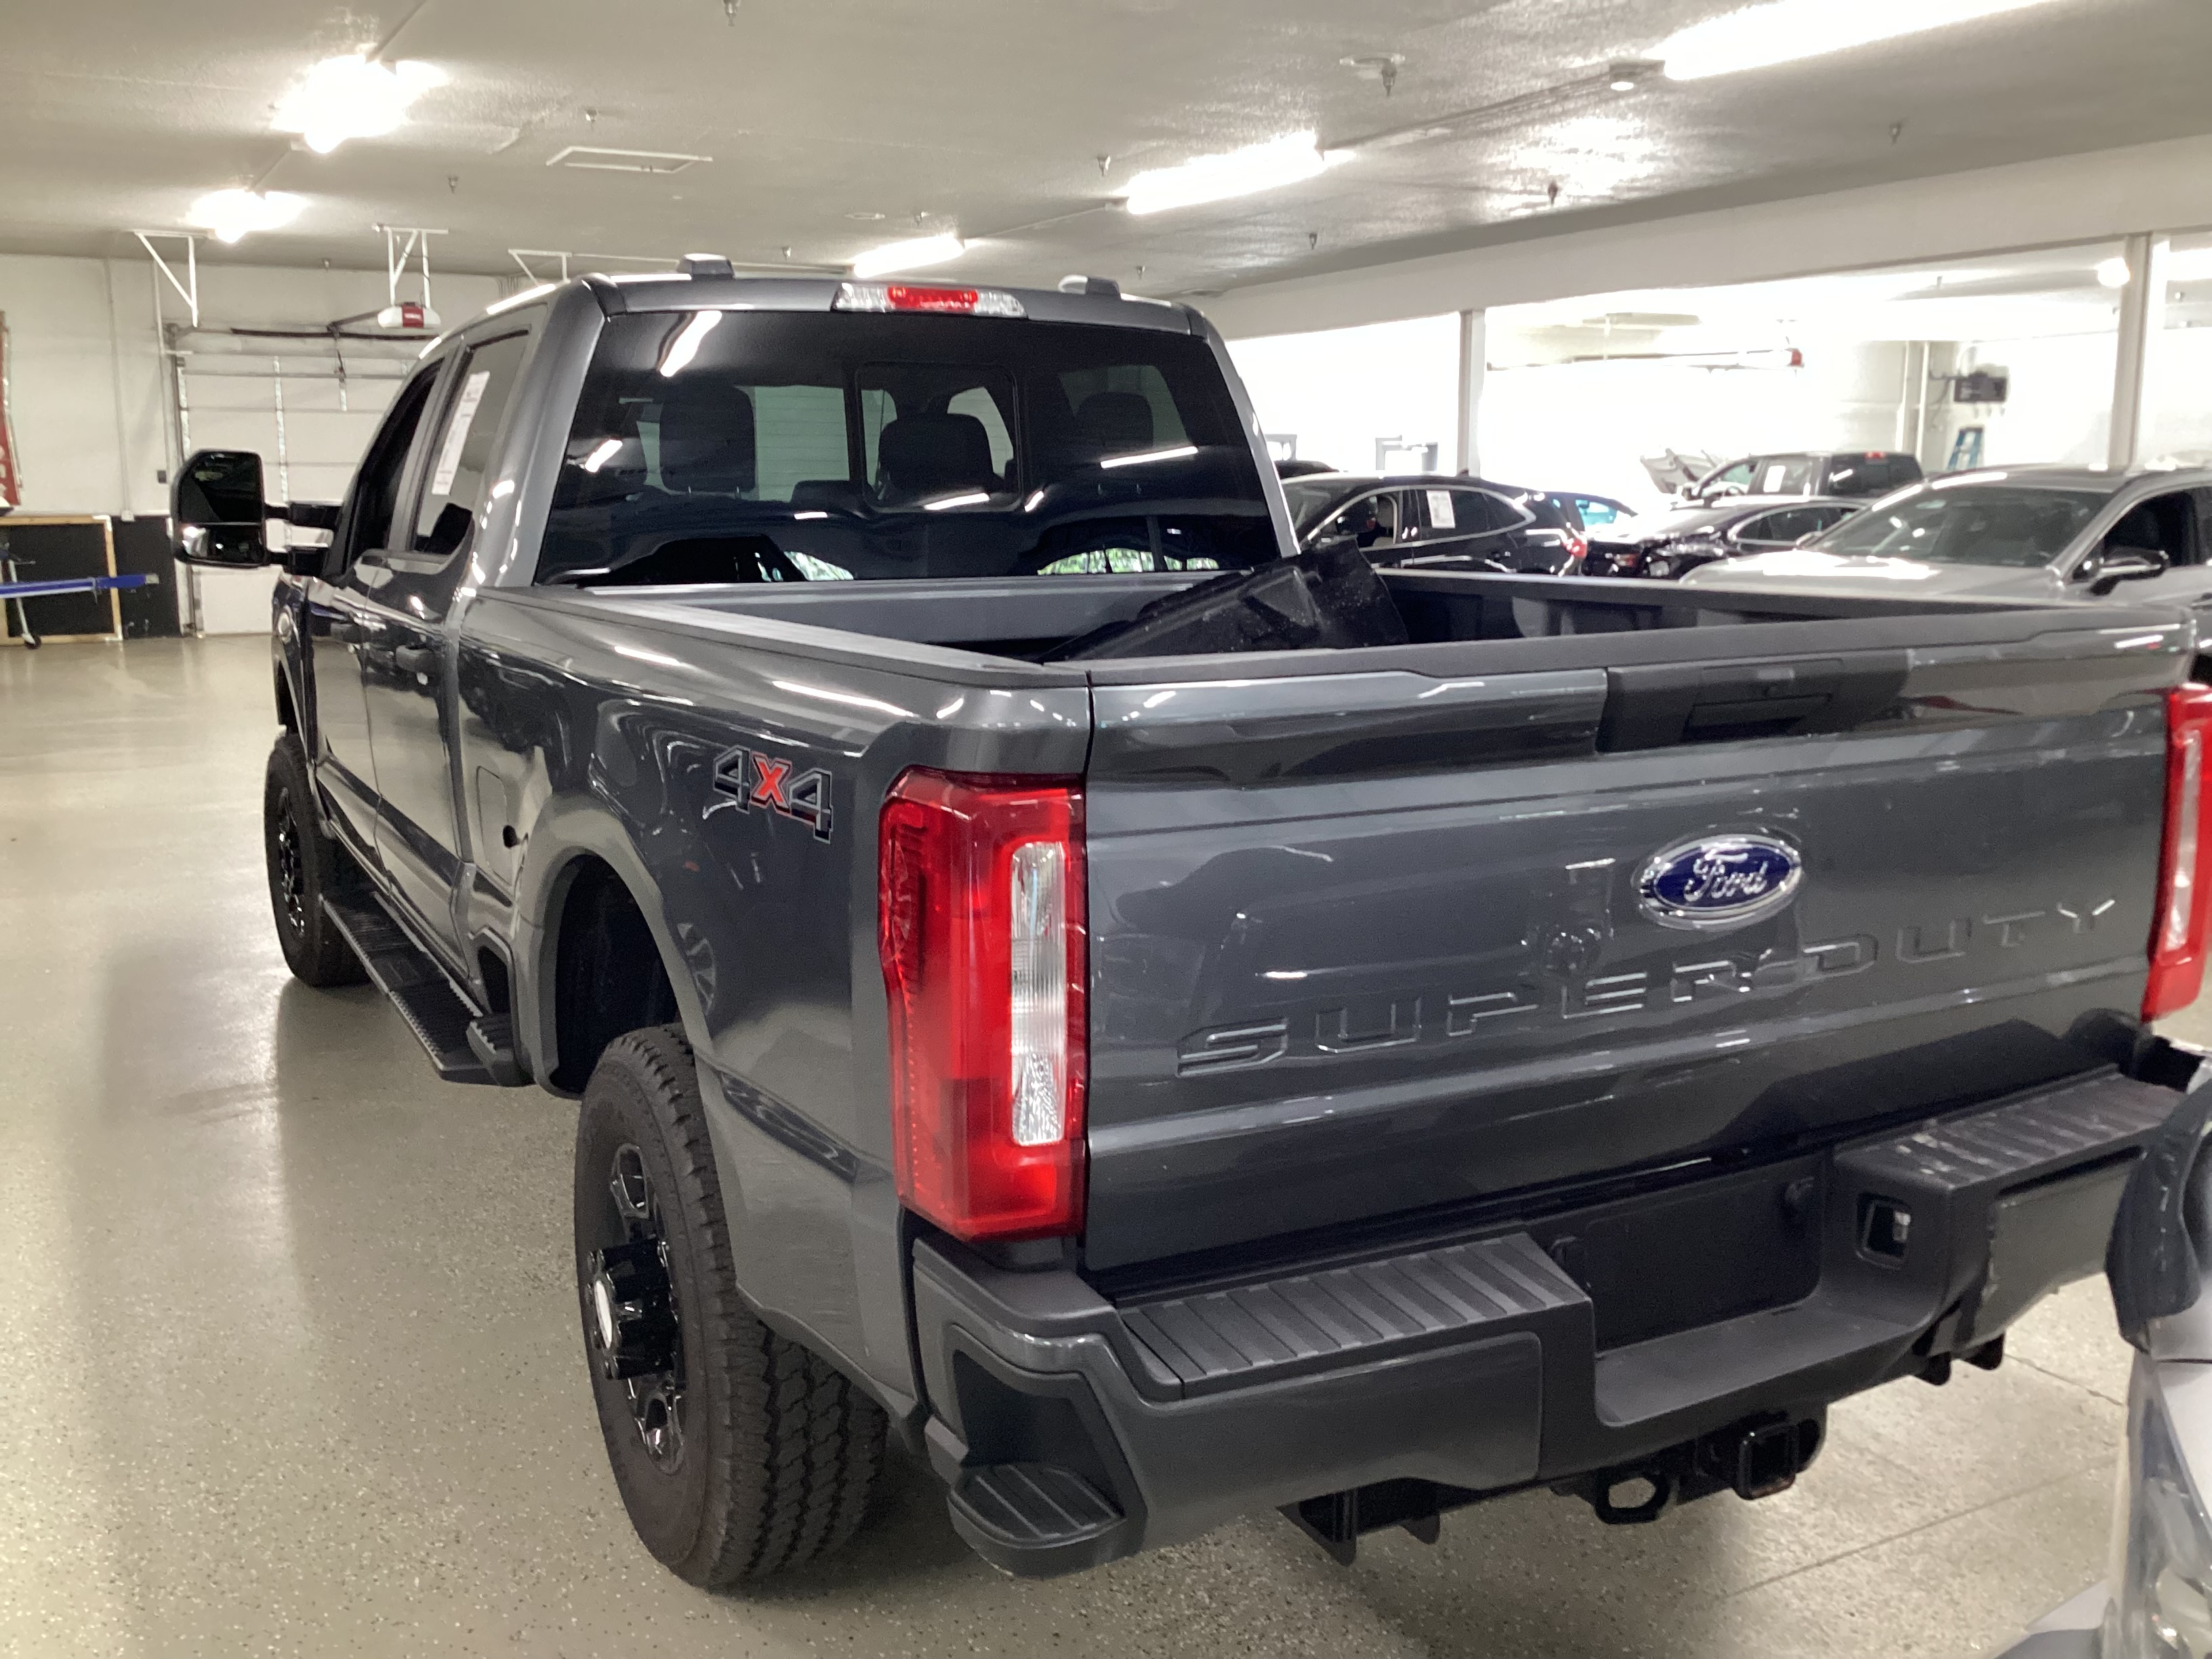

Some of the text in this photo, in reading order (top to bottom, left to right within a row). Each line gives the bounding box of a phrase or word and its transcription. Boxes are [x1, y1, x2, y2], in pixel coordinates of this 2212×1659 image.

[1683, 847, 1769, 903] Ford
[1176, 898, 2117, 1079] SUPER DUTY
